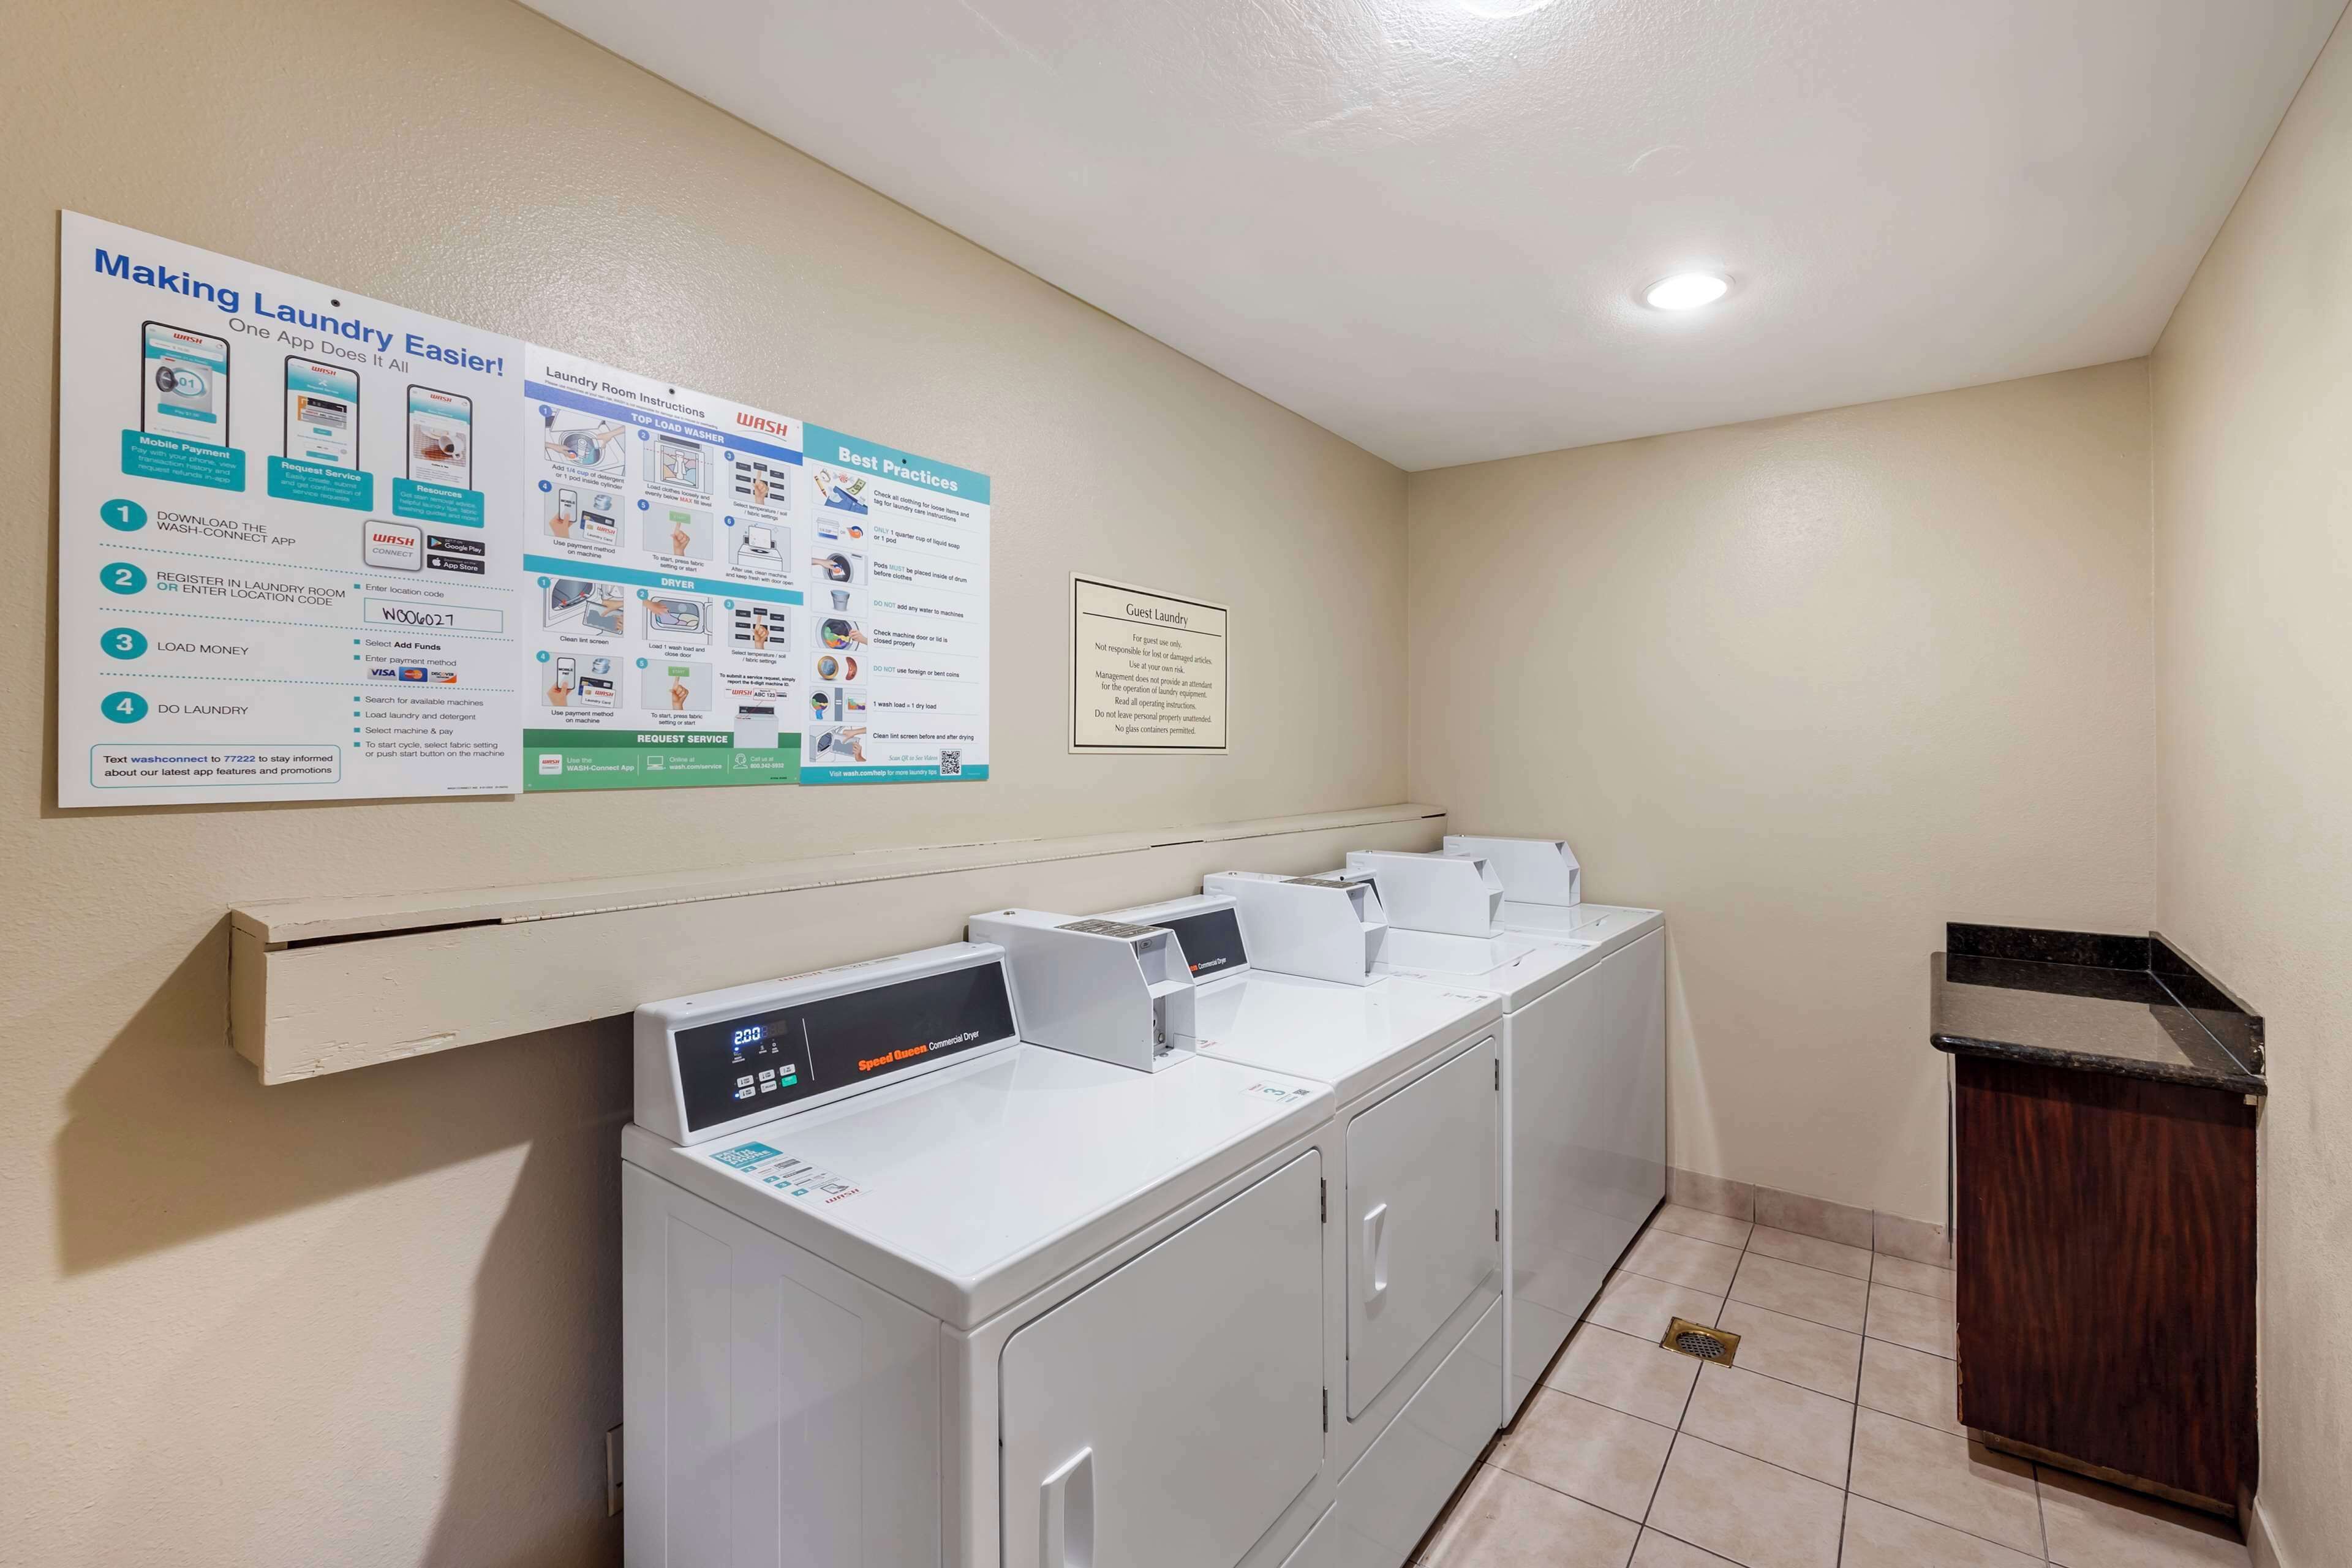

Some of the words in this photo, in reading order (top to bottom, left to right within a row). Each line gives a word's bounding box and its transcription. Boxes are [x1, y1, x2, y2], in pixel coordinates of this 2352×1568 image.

[95, 248, 239, 314] Making
[255, 292, 393, 352] Laundry
[405, 333, 503, 376] Easier!
[229, 318, 270, 339] One
[277, 331, 314, 352] App
[322, 341, 366, 363] Does
[374, 354, 383, 368] It
[388, 359, 408, 373] All
[179, 376, 196, 390] 01
[546, 366, 598, 391] Laundry
[602, 382, 636, 400] Room
[640, 393, 705, 418] Instructions
[631, 413, 652, 424] TOP
[655, 419, 682, 432] LOAD
[684, 426, 724, 443] WASHER
[736, 412, 788, 437] WASH
[140, 436, 179, 450] Mobile
[182, 443, 230, 459] Payment
[282, 461, 323, 475] Request
[325, 469, 361, 481] Service
[839, 446, 878, 470] Best
[883, 459, 958, 491] Practices
[417, 484, 462, 498] Resources
[157, 511, 238, 533] DOWNLOAD
[241, 522, 268, 537] THE
[157, 522, 268, 543] WASH-CONNECT
[271, 537, 296, 546] APP
[372, 533, 415, 549] WASH
[372, 548, 413, 557] CONNECT
[445, 543, 467, 552] Google
[469, 545, 482, 554] Play
[115, 568, 132, 586] 2
[157, 571, 225, 589] REGISTER
[228, 579, 244, 590] IN
[245, 581, 304, 594] LAUNDRY
[309, 587, 345, 598] ROOM
[661, 578, 695, 589] DRYER
[157, 582, 178, 592] OR
[183, 584, 227, 596] ENTER
[231, 589, 294, 603] LOCATION
[298, 595, 333, 606] CODE
[366, 583, 387, 592] Enter
[390, 586, 421, 595] location
[1126, 603, 1152, 619] Guest
[1155, 609, 1188, 628] Laundry
[116, 634, 133, 650] 3
[158, 642, 195, 652] LOAD
[200, 644, 249, 655] MONEY
[1133, 633, 1142, 642] For
[1170, 640, 1182, 649] only.
[1129, 660, 1140, 669] Use
[116, 698, 134, 714] 4
[159, 704, 180, 714] DO
[184, 706, 248, 715] LAUNDRY
[1115, 696, 1129, 706] Read
[1139, 699, 1165, 709] operating
[1166, 701, 1196, 709] instructions.
[1095, 709, 1104, 718] Do
[1118, 710, 1133, 719] leave
[1125, 724, 1139, 734] glass
[1140, 725, 1169, 734] containers
[1169, 726, 1196, 735] permitted.
[637, 734, 685, 743] REQUEST
[281, 767, 332, 775] promotions
[1198, 959, 1217, 970] Commercial
[734, 1027, 761, 1045] 2.00
[858, 1053, 892, 1071] Speed
[894, 1044, 927, 1061] Queen
[929, 1035, 963, 1051] Commercial
[964, 1030, 979, 1042] Dryer
[826, 1188, 860, 1204] WASH
